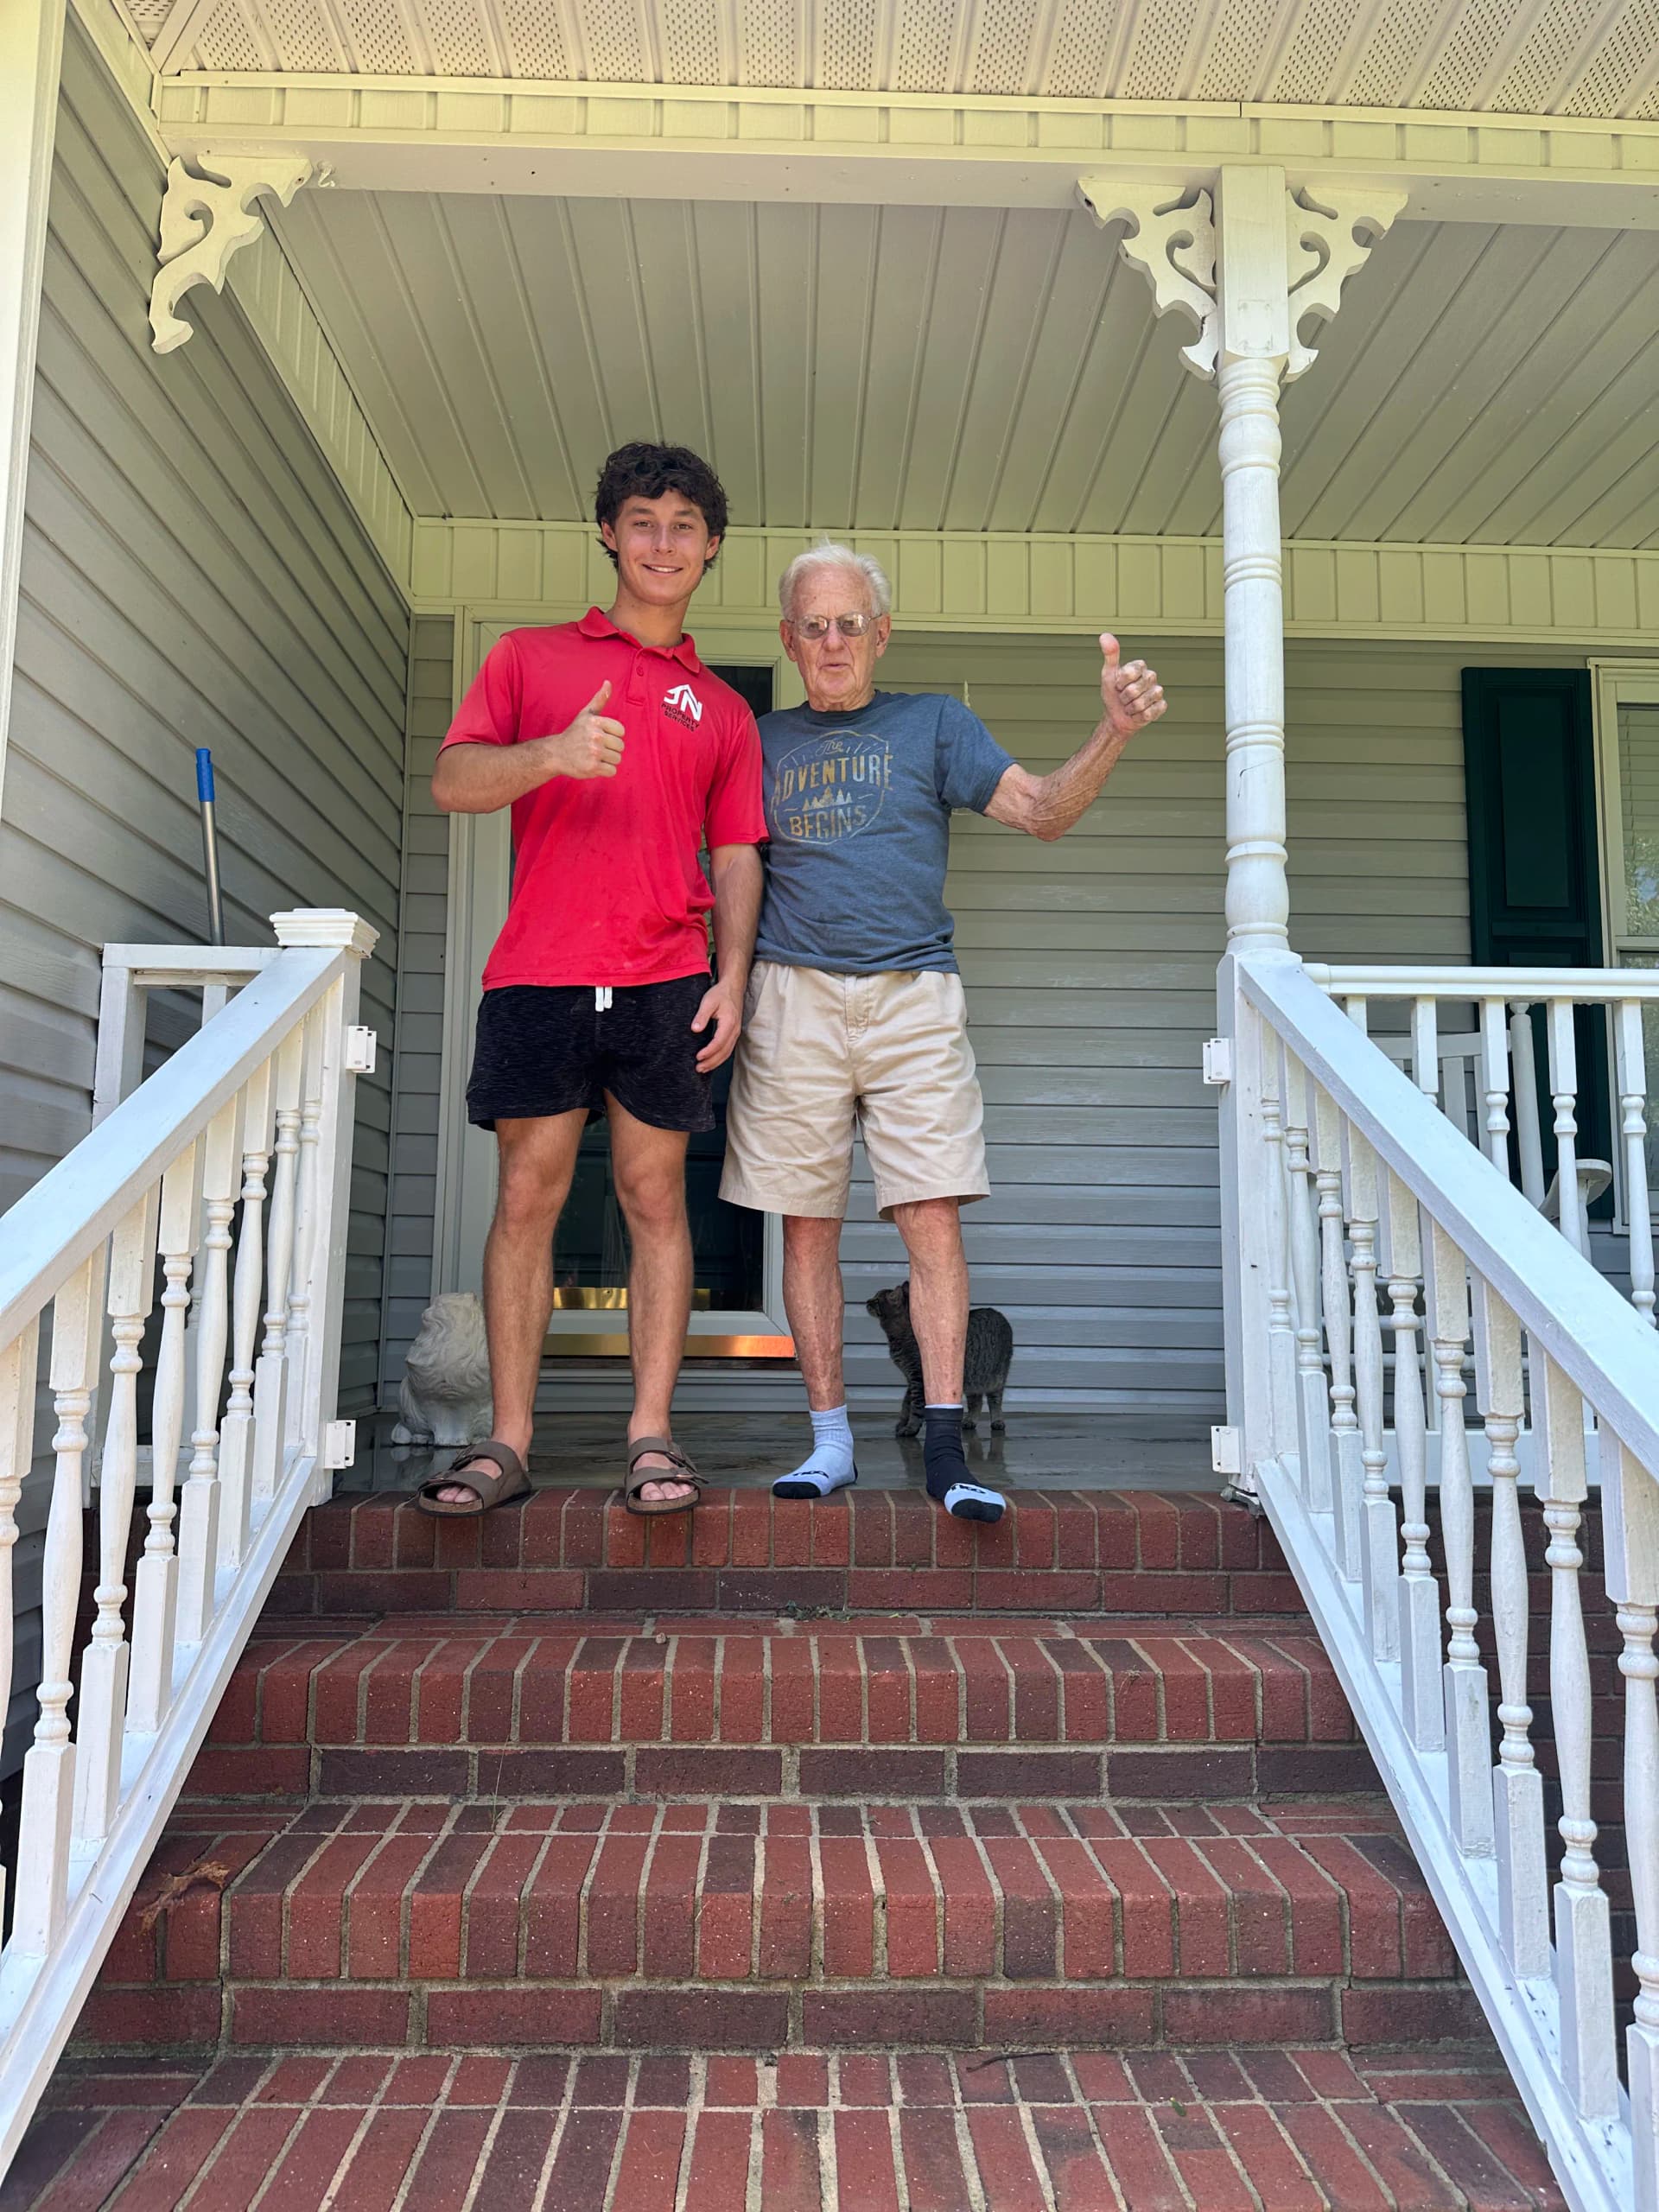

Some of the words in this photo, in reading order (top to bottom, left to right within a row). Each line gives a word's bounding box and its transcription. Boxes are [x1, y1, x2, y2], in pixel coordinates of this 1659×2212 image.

[661, 703, 700, 728] PROPERTY
[664, 711, 695, 733] SERVICES
[816, 740, 843, 756] The
[770, 754, 894, 814] ADVENTURE
[789, 805, 868, 839] BEGINS
